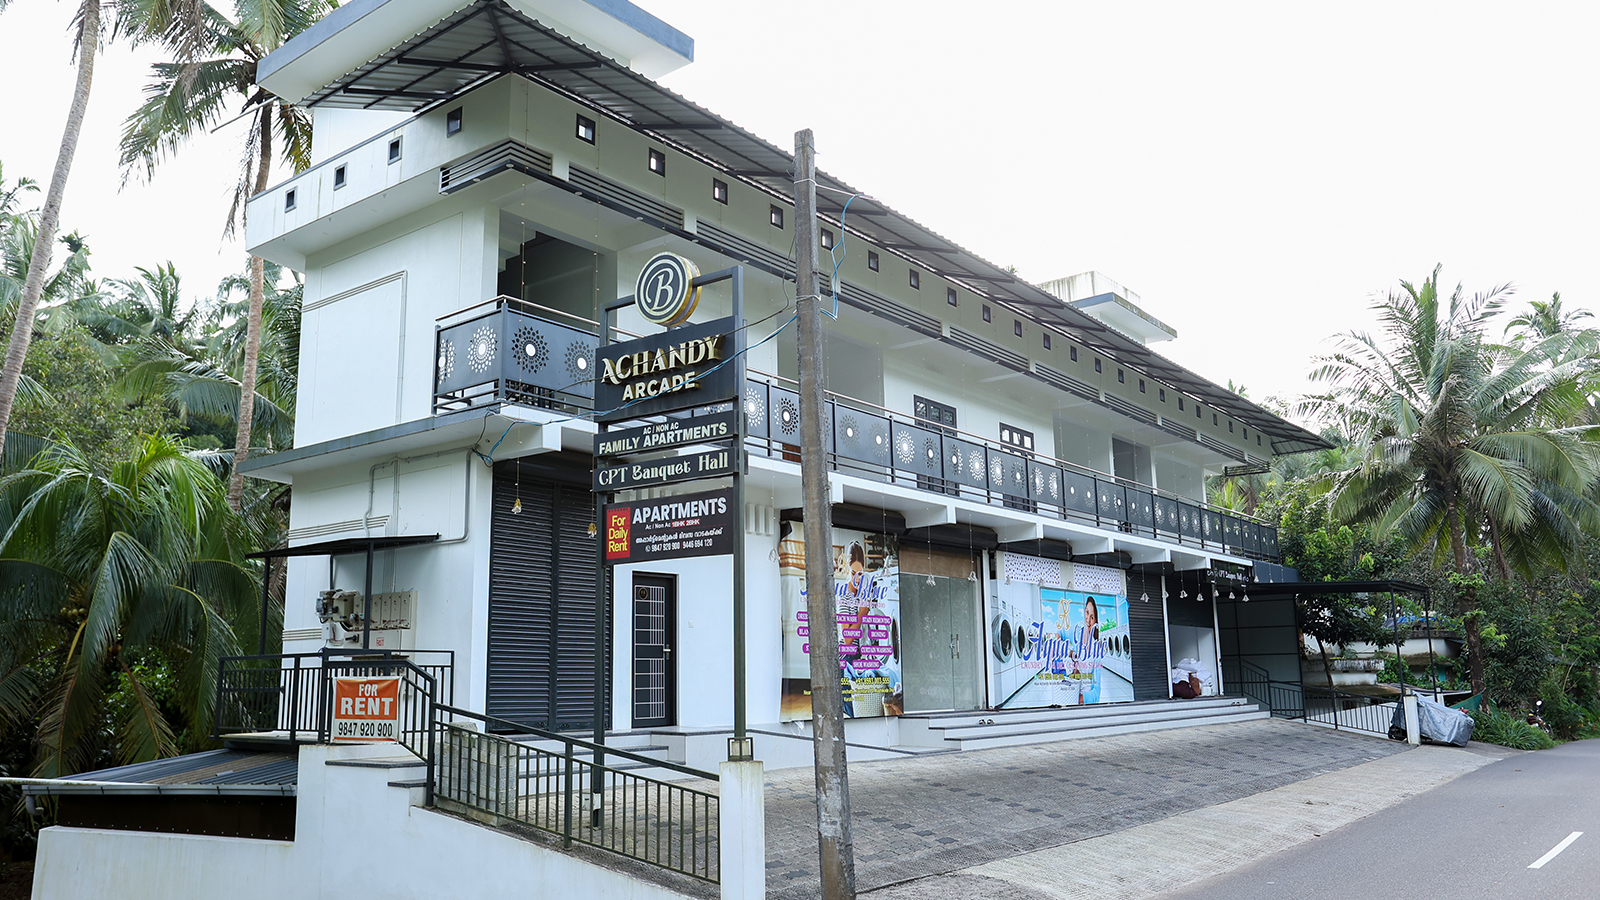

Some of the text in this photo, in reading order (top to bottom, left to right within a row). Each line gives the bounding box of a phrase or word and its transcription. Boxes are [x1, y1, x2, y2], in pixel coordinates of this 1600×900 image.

[601, 333, 722, 385] ACHANDY
[622, 371, 698, 401] ARCADE
[643, 427, 652, 435] AC
[655, 423, 669, 433] NON
[670, 421, 679, 431] AC
[599, 422, 728, 455] FAMILY APARTMENTS
[598, 452, 728, 486] CPT Banquet Hall
[632, 496, 727, 525] APARTMENTS
[611, 515, 626, 527] For
[608, 527, 629, 541] Daily
[608, 540, 628, 553] Rent
[651, 543, 662, 552] 9847
[663, 542, 671, 551] 920
[704, 538, 713, 547] 120
[853, 570, 888, 600] Blue
[1022, 621, 1107, 672] Aqua Blue
[358, 683, 378, 697] FOR
[340, 697, 394, 716] RENT
[338, 722, 393, 737] 9847 920 900
